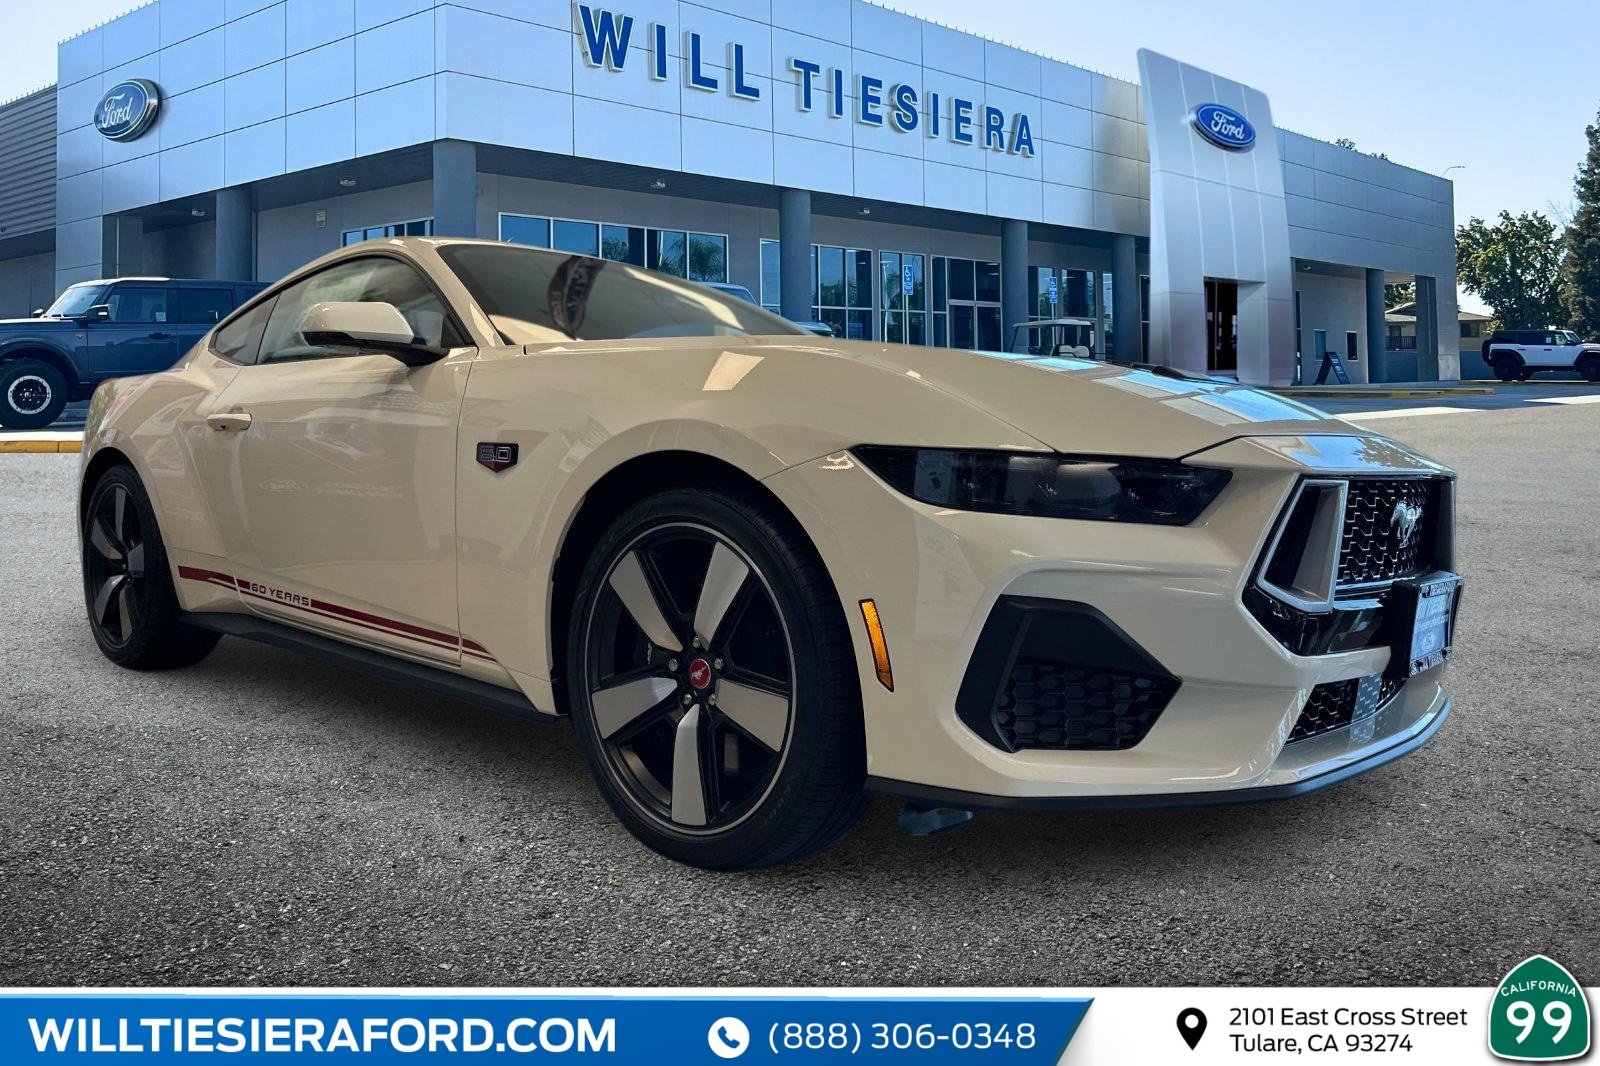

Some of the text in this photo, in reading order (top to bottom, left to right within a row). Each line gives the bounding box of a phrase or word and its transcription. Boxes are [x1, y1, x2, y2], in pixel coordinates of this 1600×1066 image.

[575, 3, 1036, 158] WILL TIESIERA
[101, 93, 133, 128] Ford
[1210, 110, 1245, 139] Ford
[251, 583, 310, 607] 60 YEARS
